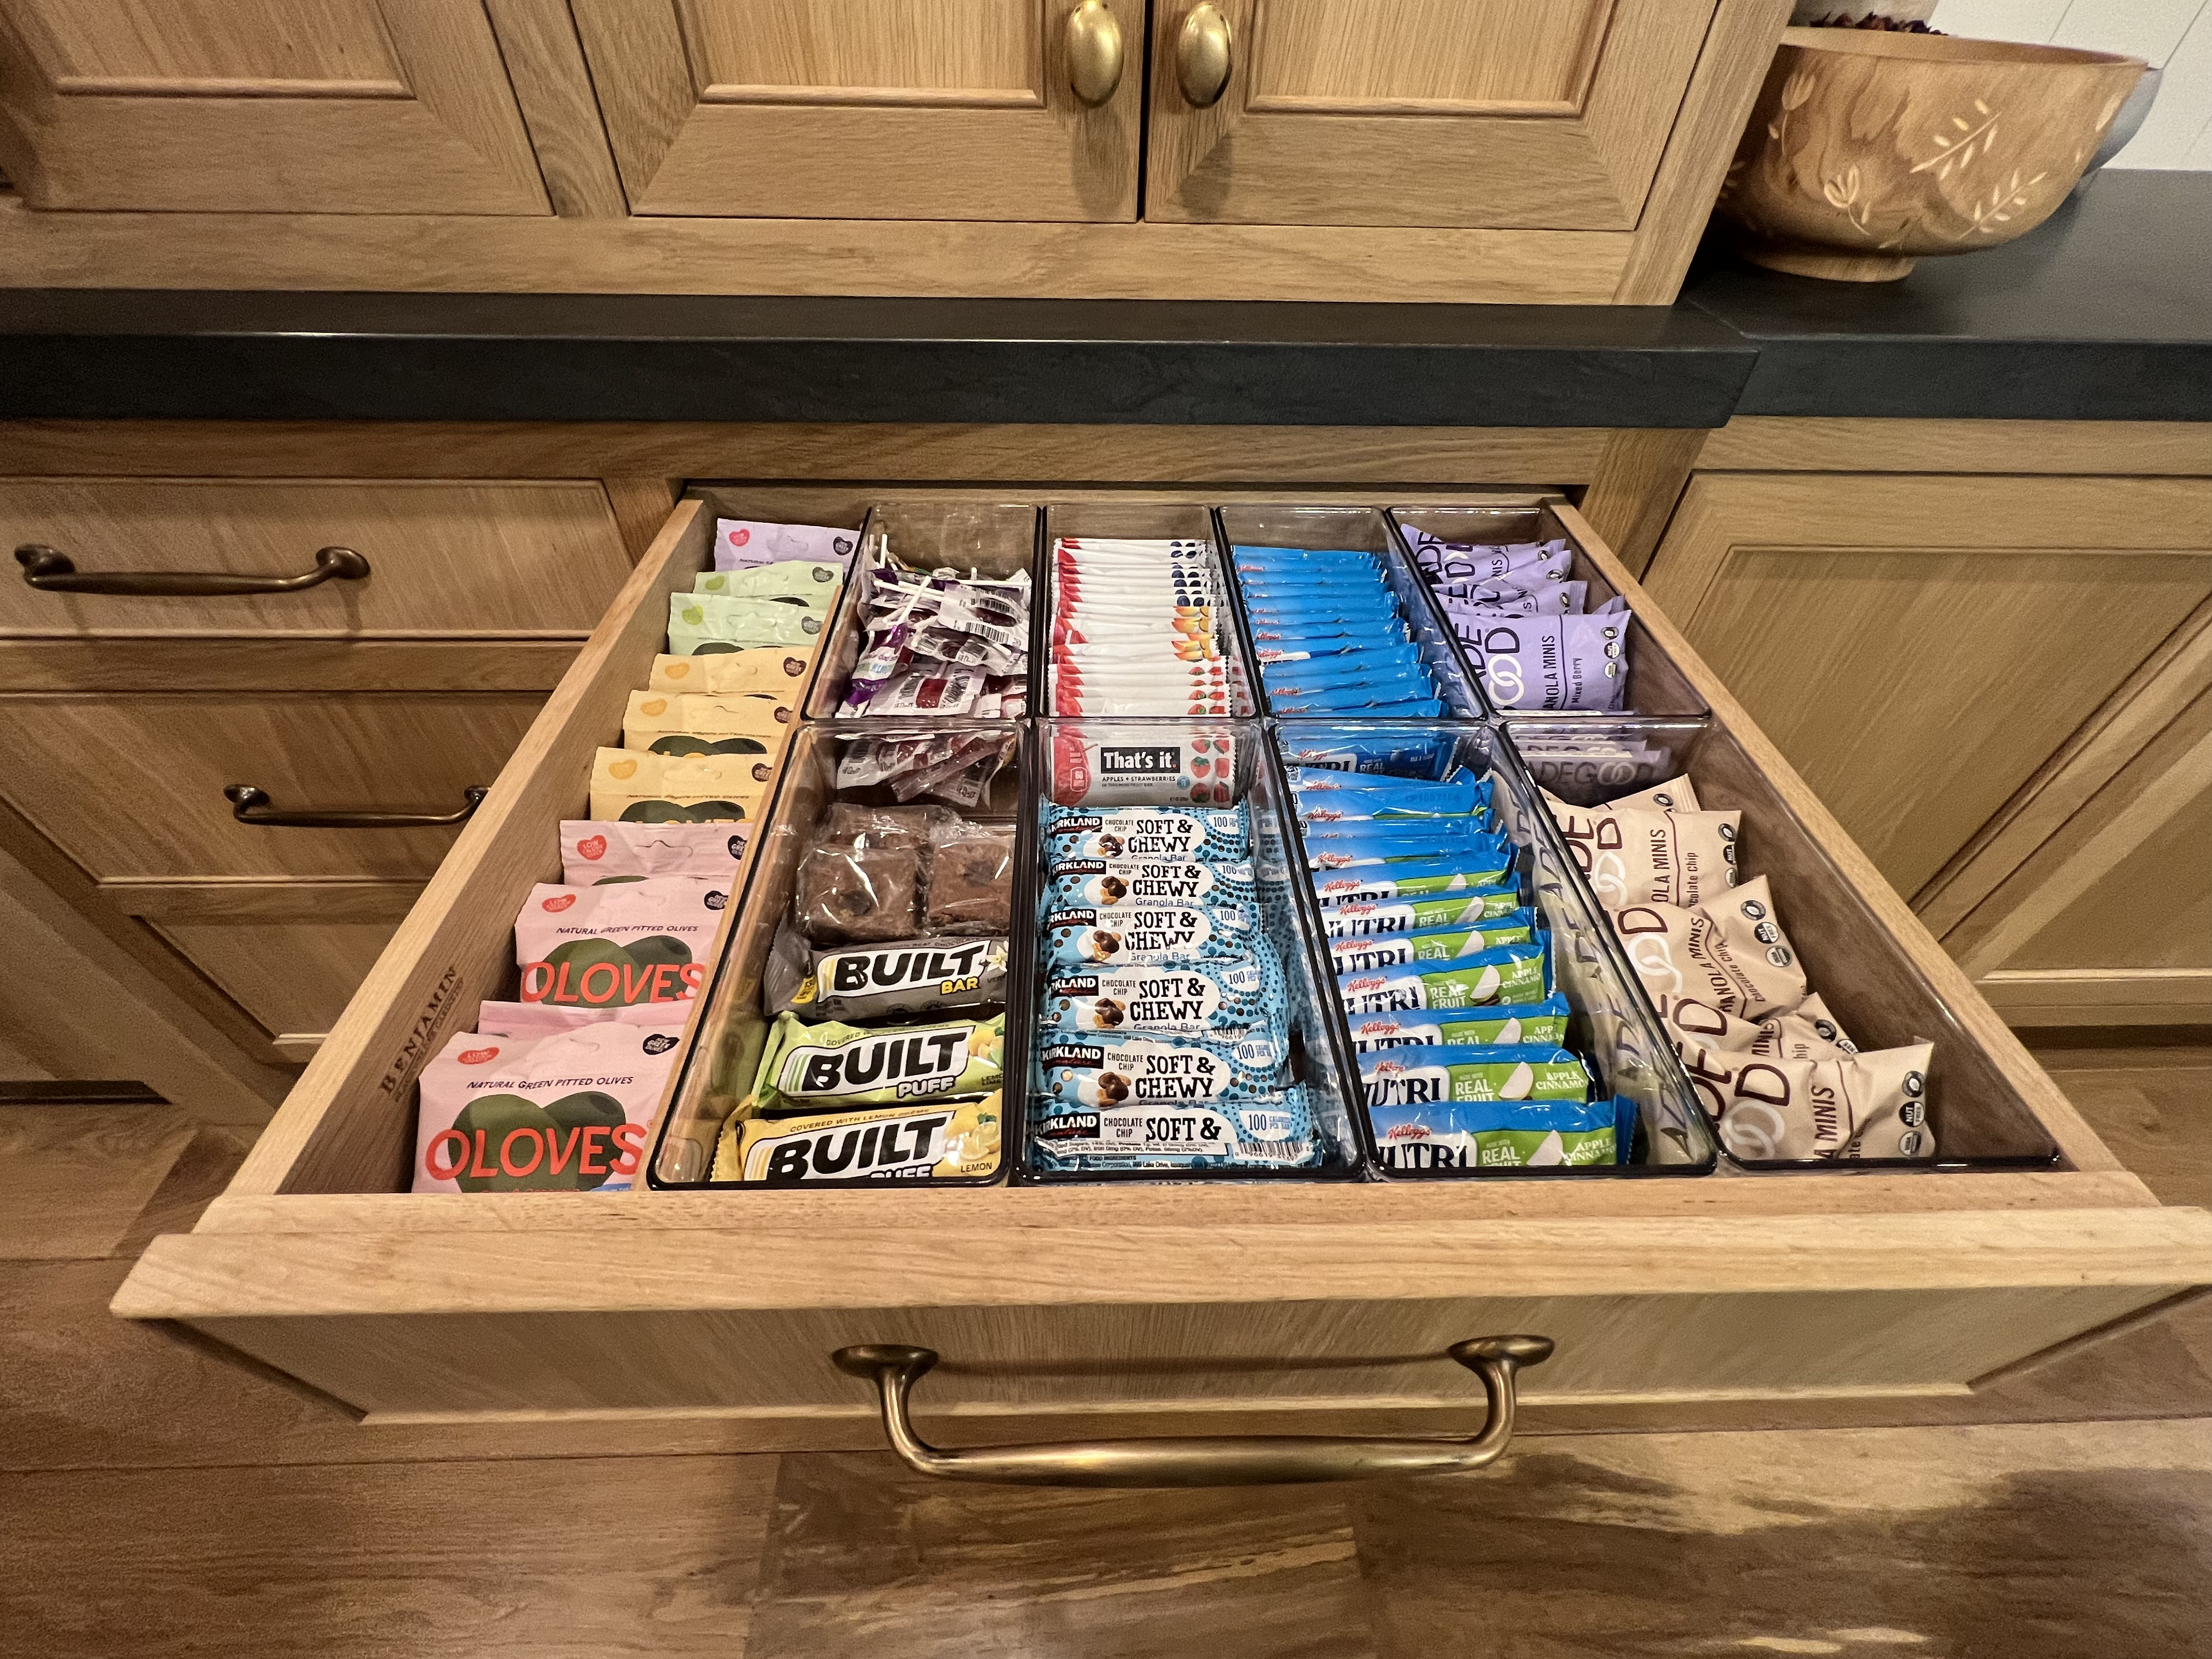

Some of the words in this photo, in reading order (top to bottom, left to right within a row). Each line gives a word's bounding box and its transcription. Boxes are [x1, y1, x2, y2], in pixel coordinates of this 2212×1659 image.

[1542, 635, 1557, 670] MINIS
[1572, 657, 1583, 681] Berry
[1571, 682, 1583, 704] Mixed
[1103, 751, 1153, 769] That's
[1136, 819, 1174, 835] SOFT
[1177, 819, 1194, 834] &
[1213, 816, 1228, 827] 100
[1128, 836, 1192, 854] CHEWY
[1650, 828, 1671, 871] MINIS
[1222, 865, 1237, 874] 100
[1684, 852, 1699, 873] Chip
[1142, 865, 1182, 879] SOFT
[1184, 865, 1201, 879] &
[1132, 879, 1199, 898] CHEWY
[1135, 898, 1174, 906] Granola
[1099, 912, 1132, 920] CHOCOLATE
[1134, 911, 1176, 929] SOFT
[1179, 911, 1198, 928] &
[1220, 910, 1235, 921] 100
[1419, 912, 1451, 928] REAL
[556, 927, 597, 935] NATURAL
[1688, 917, 1707, 960] MINIS
[1757, 928, 1770, 941] NUT
[1125, 930, 1195, 951] CHEWY
[1172, 952, 1190, 961] Bar
[1418, 948, 1450, 960] REAL
[1714, 940, 1733, 962] Chip
[834, 944, 985, 991] BUILT
[1333, 948, 1406, 976] UTRI
[1228, 970, 1245, 984] 100
[1511, 966, 1538, 979] APPLE
[521, 961, 706, 1003] OLOVES
[941, 977, 980, 995] BAR
[1102, 979, 1136, 988] CHOCOLATE
[1138, 978, 1183, 1000] SOFT
[1187, 978, 1206, 997] &
[1347, 977, 1386, 992] Kellogg's
[1729, 964, 1766, 1002] Chocolate
[1346, 986, 1421, 1015] UTRI
[1432, 995, 1467, 1009] FRUIT
[1130, 1000, 1204, 1022] CHEWY
[380, 965, 457, 1093] BENJAMIN
[1042, 1046, 1102, 1062] KIRKLAND
[1107, 1052, 1144, 1063] CHOCOLATE
[1237, 1043, 1255, 1060] 100
[1792, 1043, 1810, 1059] hip
[801, 1031, 967, 1091] BUILT
[1146, 1054, 1193, 1075] SOFT
[1196, 1056, 1216, 1075] &
[466, 1081, 515, 1089] NATURAL
[518, 1080, 554, 1090] GREEN
[555, 1078, 594, 1086] PITTED
[596, 1076, 634, 1085] OLIVES
[1546, 1071, 1581, 1081] APPLE
[898, 1077, 955, 1098] PUFF
[1135, 1076, 1214, 1098] CHEWY
[1454, 1079, 1493, 1096] REAL
[1810, 1085, 1838, 1142] MINIS
[1905, 1106, 1914, 1122] NUT
[790, 1120, 833, 1132] COVERED
[836, 1116, 861, 1125] WITH
[1104, 1118, 1143, 1127] CHOCOLATE
[1146, 1117, 1197, 1142] SOFT
[1200, 1117, 1222, 1141] &
[1248, 1114, 1267, 1131] 100
[1116, 1128, 1133, 1138] CHIP
[425, 1123, 647, 1181] OLOVES
[768, 1116, 948, 1180] BUILT
[1573, 1137, 1612, 1152] APPLE
[1481, 1146, 1521, 1164] REAL
[960, 1161, 993, 1173] LEMON
